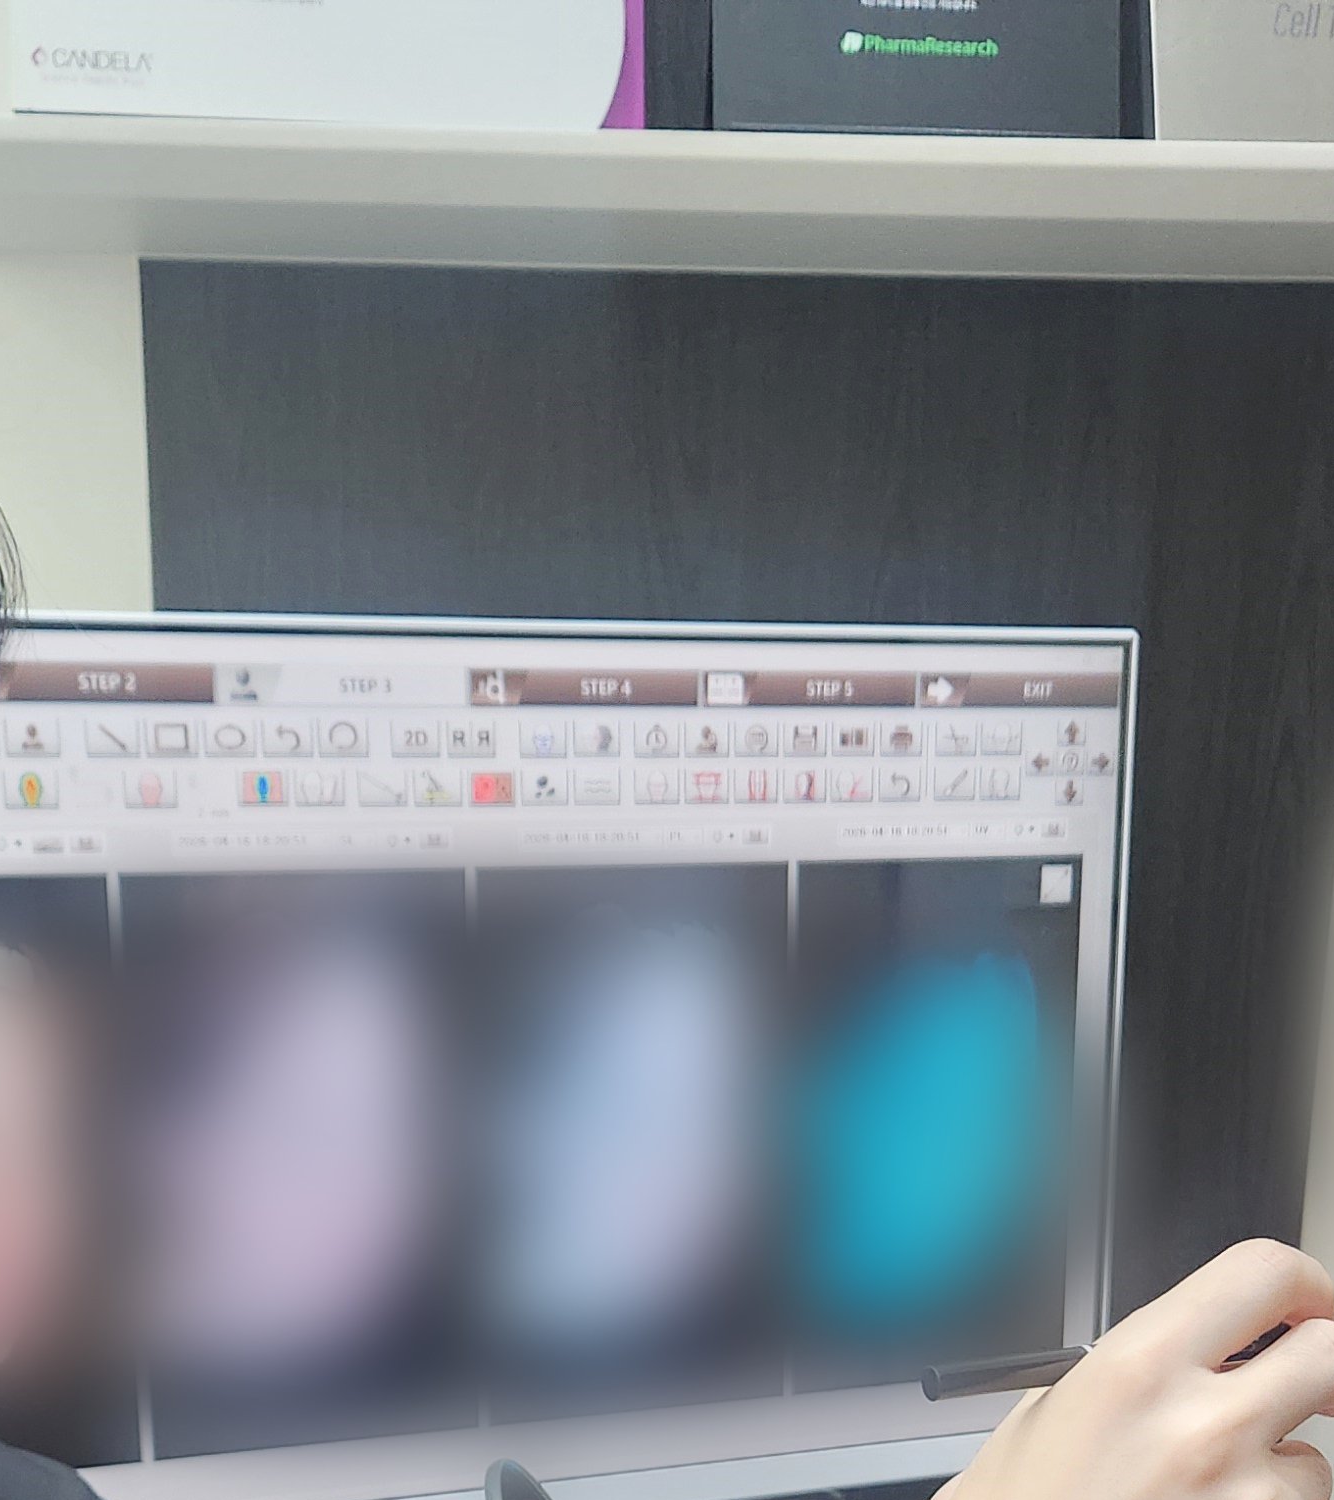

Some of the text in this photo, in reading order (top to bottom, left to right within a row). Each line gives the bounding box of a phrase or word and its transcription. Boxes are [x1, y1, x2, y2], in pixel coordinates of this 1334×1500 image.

[1273, 3, 1321, 39] Cell
[864, 34, 999, 56] PharmaResearch
[51, 47, 153, 72] CANDELA
[77, 671, 137, 694] STEP 2
[338, 677, 392, 694] STEP 3
[580, 677, 632, 697] STEP 4
[805, 679, 854, 698] STEP 5
[1023, 681, 1054, 698] EXIT
[403, 730, 428, 746] 2D
